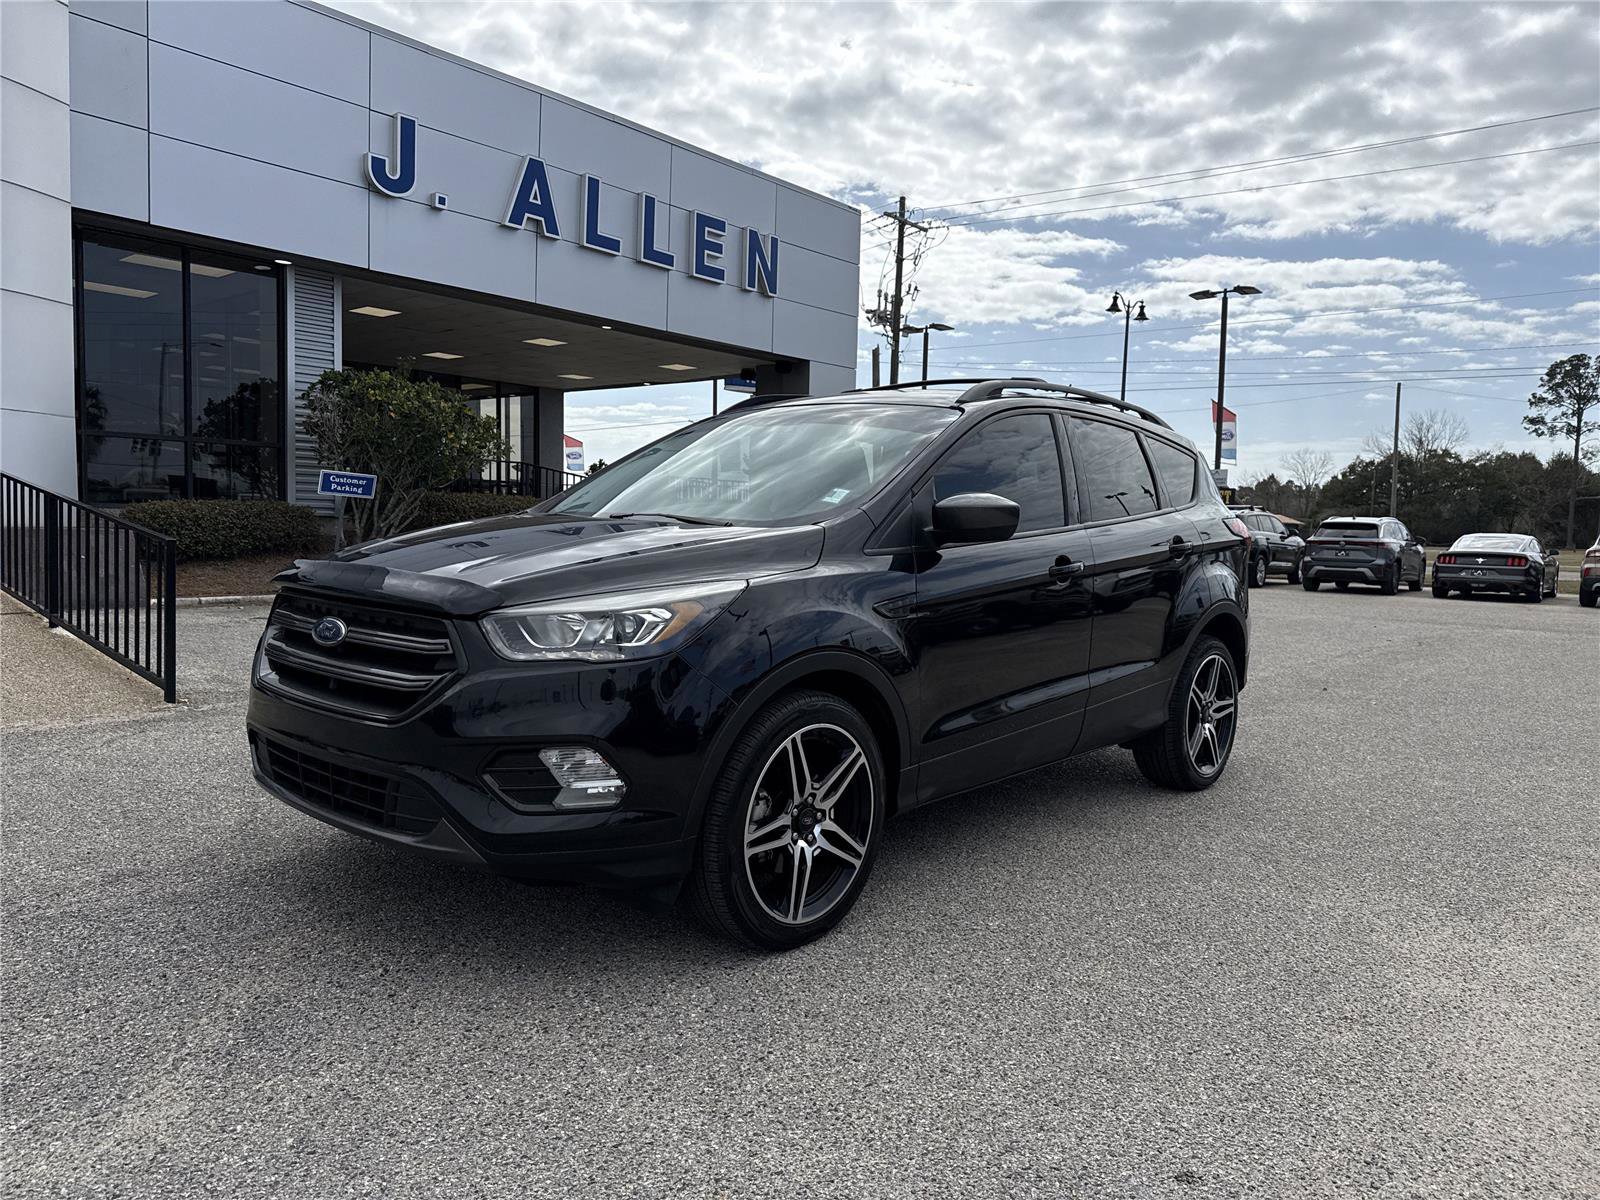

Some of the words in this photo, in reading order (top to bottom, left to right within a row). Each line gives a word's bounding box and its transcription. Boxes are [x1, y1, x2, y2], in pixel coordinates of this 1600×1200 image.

[363, 112, 449, 211] J.
[501, 154, 781, 297] ALLEN
[330, 475, 367, 485] Customer
[331, 483, 363, 494] Parking
